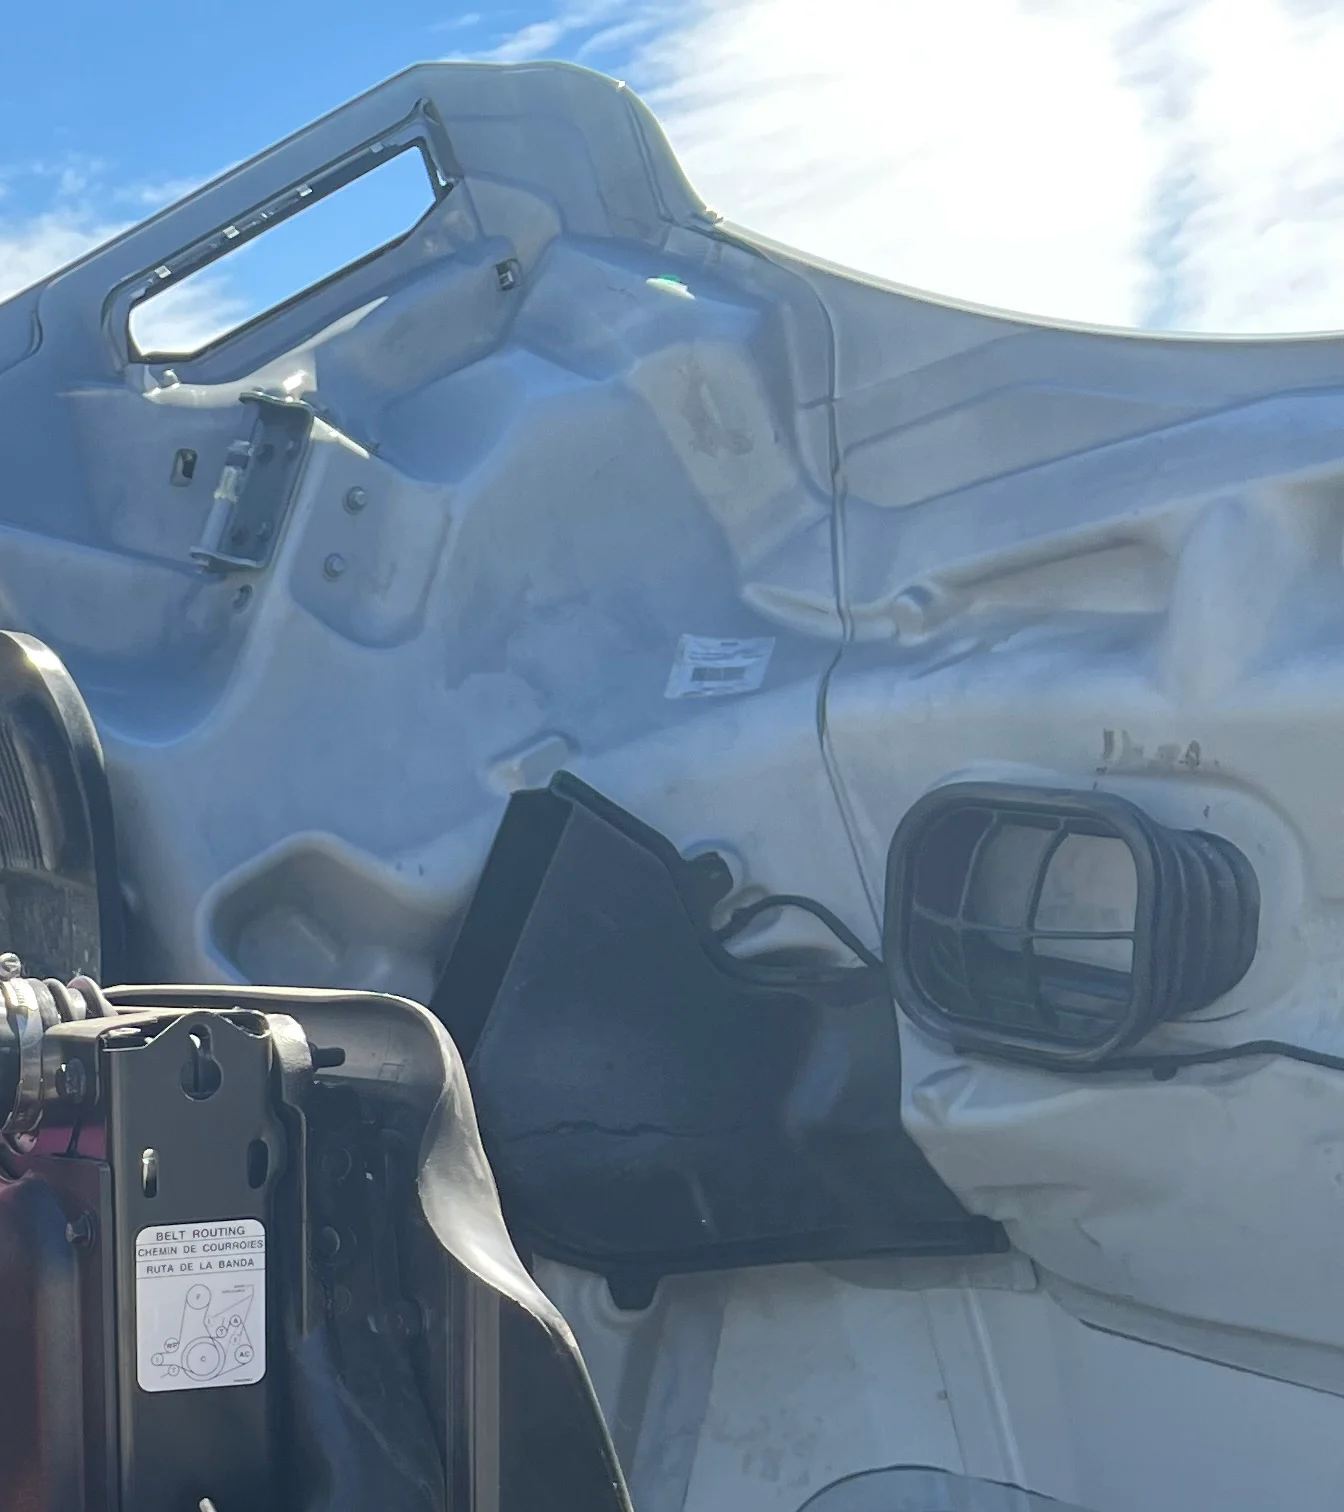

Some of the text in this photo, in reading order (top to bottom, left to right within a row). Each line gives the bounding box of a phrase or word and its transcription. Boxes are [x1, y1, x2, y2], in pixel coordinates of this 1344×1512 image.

[156, 1226, 246, 1242] BELT ROUTING
[137, 1240, 264, 1257] CHEMIN DE COURROIES
[146, 1258, 255, 1275] RUTA DE LA BANDA
